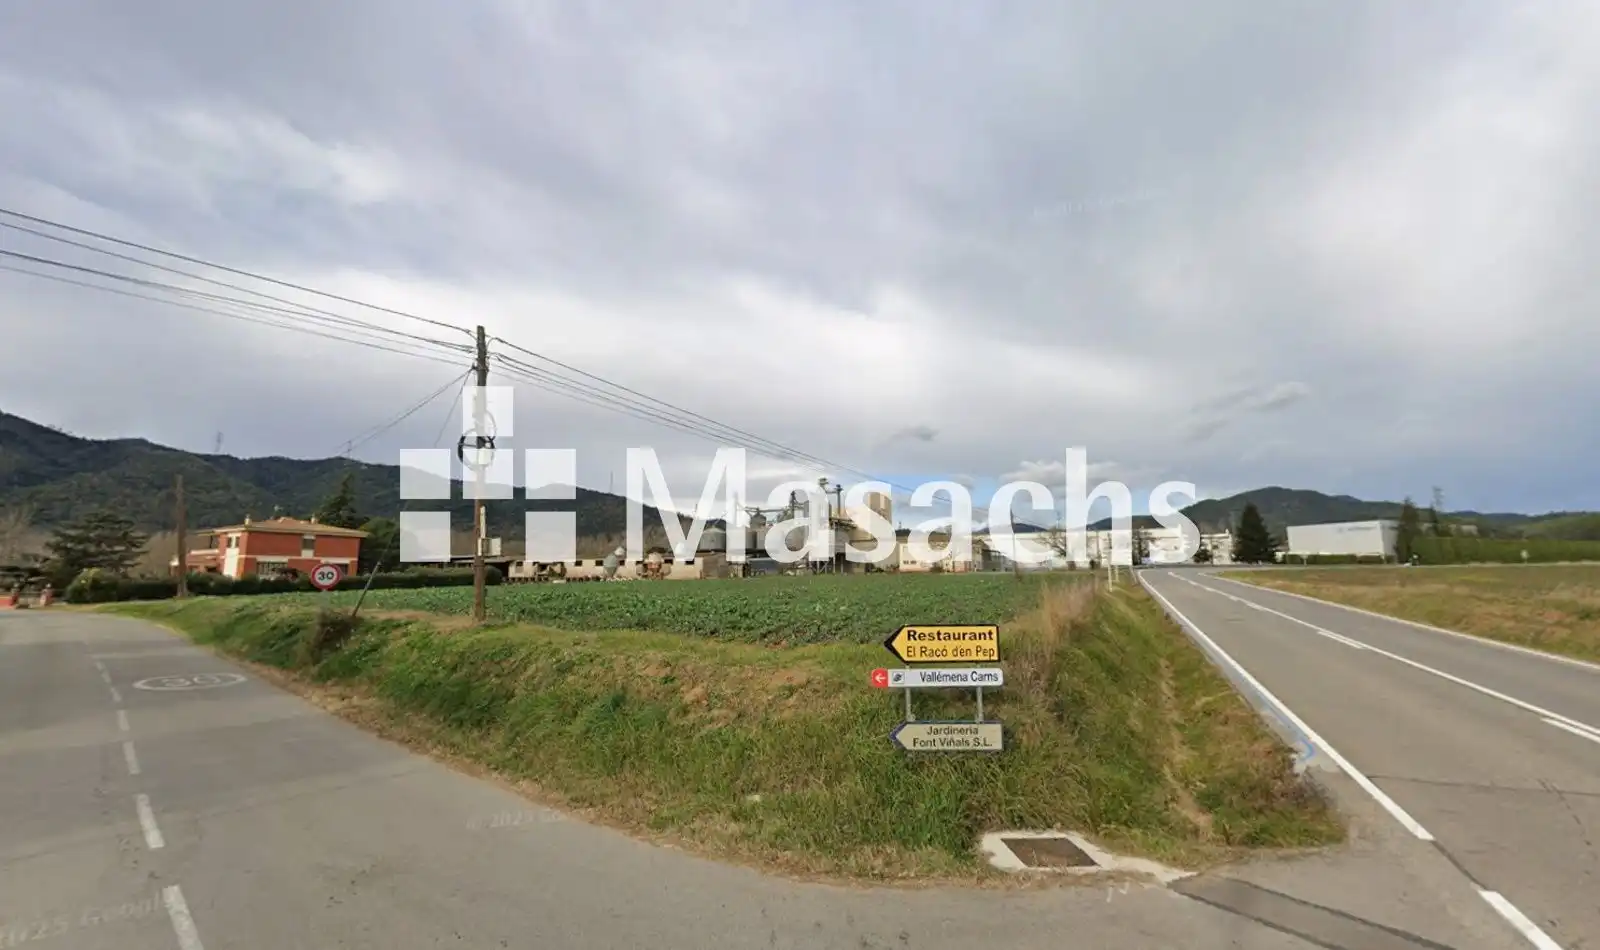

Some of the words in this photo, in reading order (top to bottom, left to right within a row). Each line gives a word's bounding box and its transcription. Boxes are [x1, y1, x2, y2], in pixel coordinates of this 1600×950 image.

[318, 571, 334, 580] 30
[906, 629, 994, 641] Restaurant
[906, 645, 916, 658] El
[920, 645, 948, 658] Racó
[975, 645, 995, 660] Pep
[912, 738, 936, 748] Font
